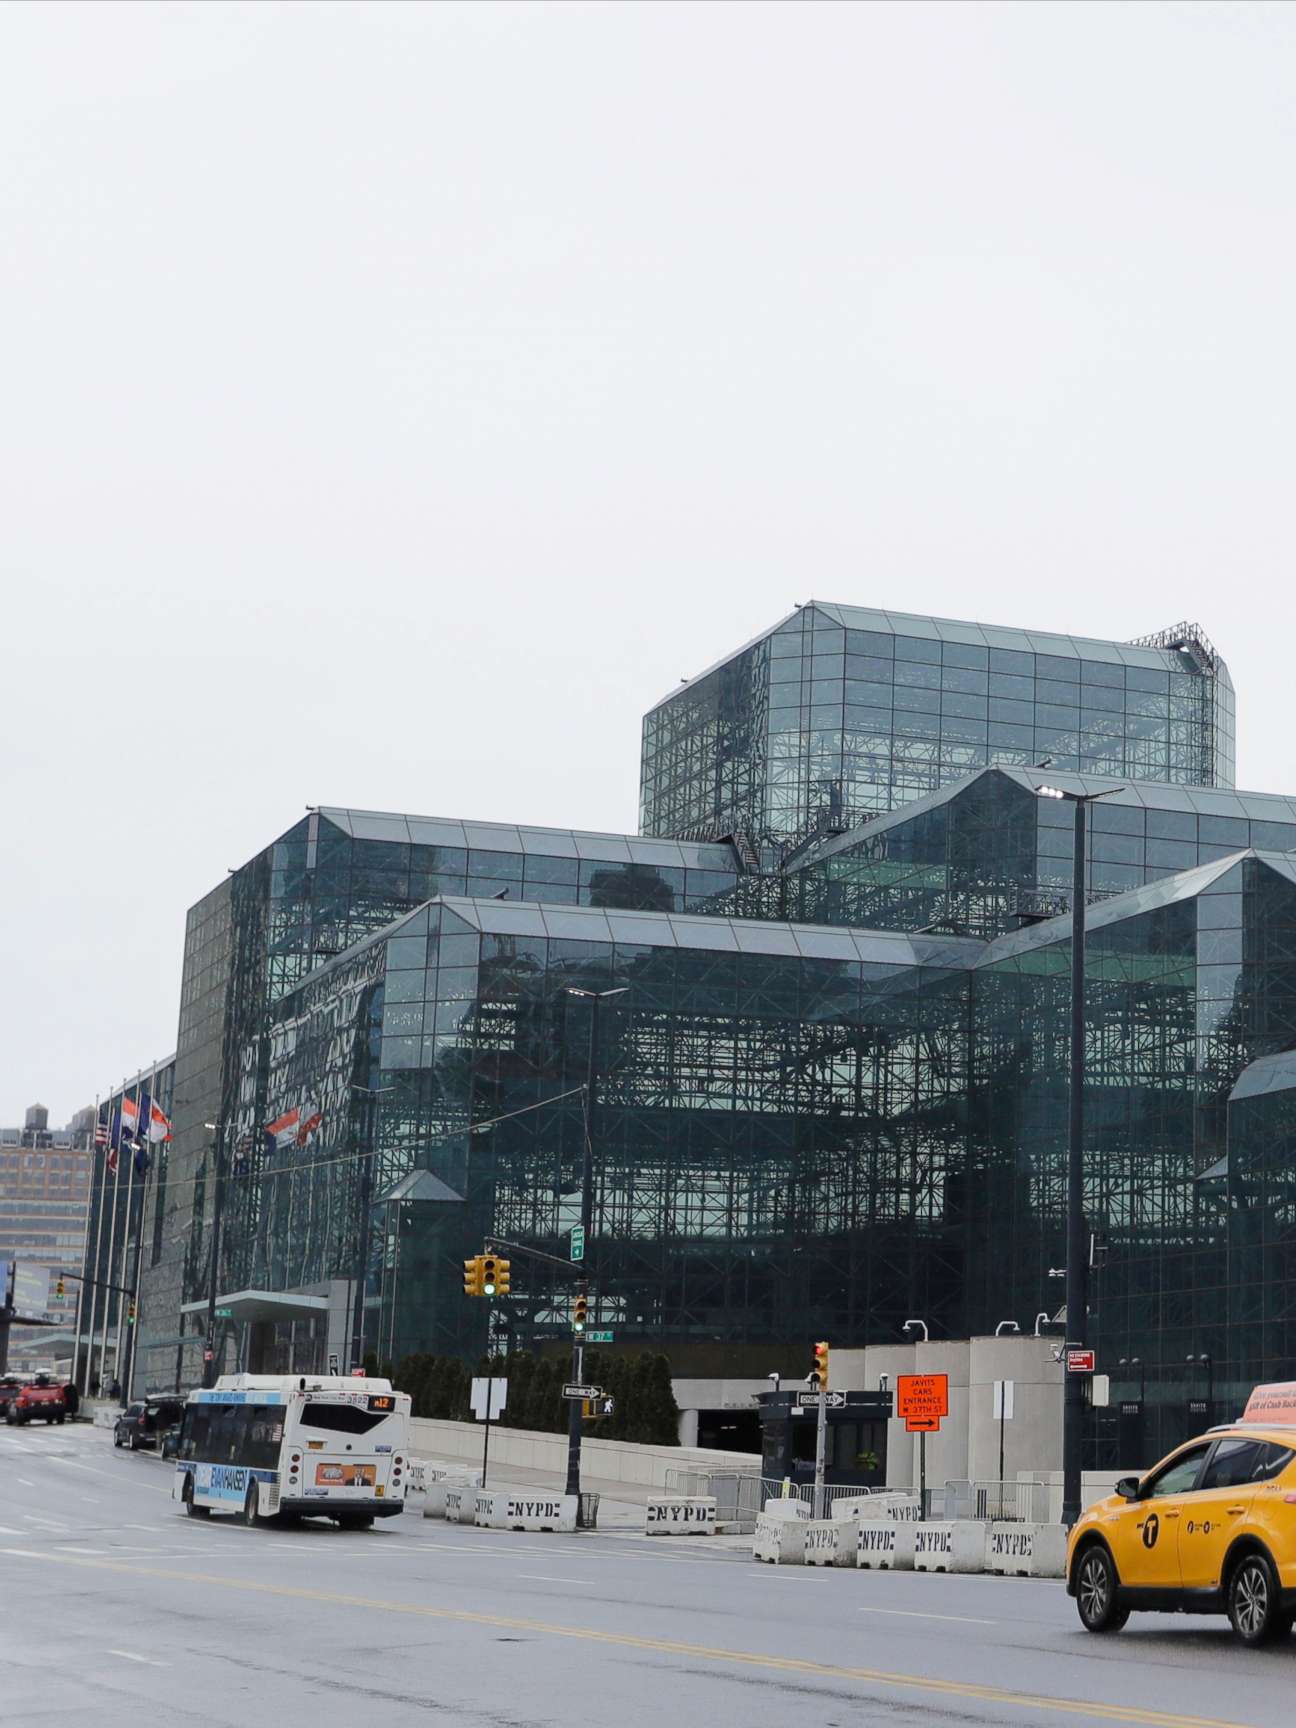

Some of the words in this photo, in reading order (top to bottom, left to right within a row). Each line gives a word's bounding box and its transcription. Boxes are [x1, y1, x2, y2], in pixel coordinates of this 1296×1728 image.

[515, 1502, 554, 1517] NYPD
[656, 1506, 706, 1521] NYPD
[862, 1530, 890, 1550] NYPD
[919, 1531, 947, 1552] NYPD
